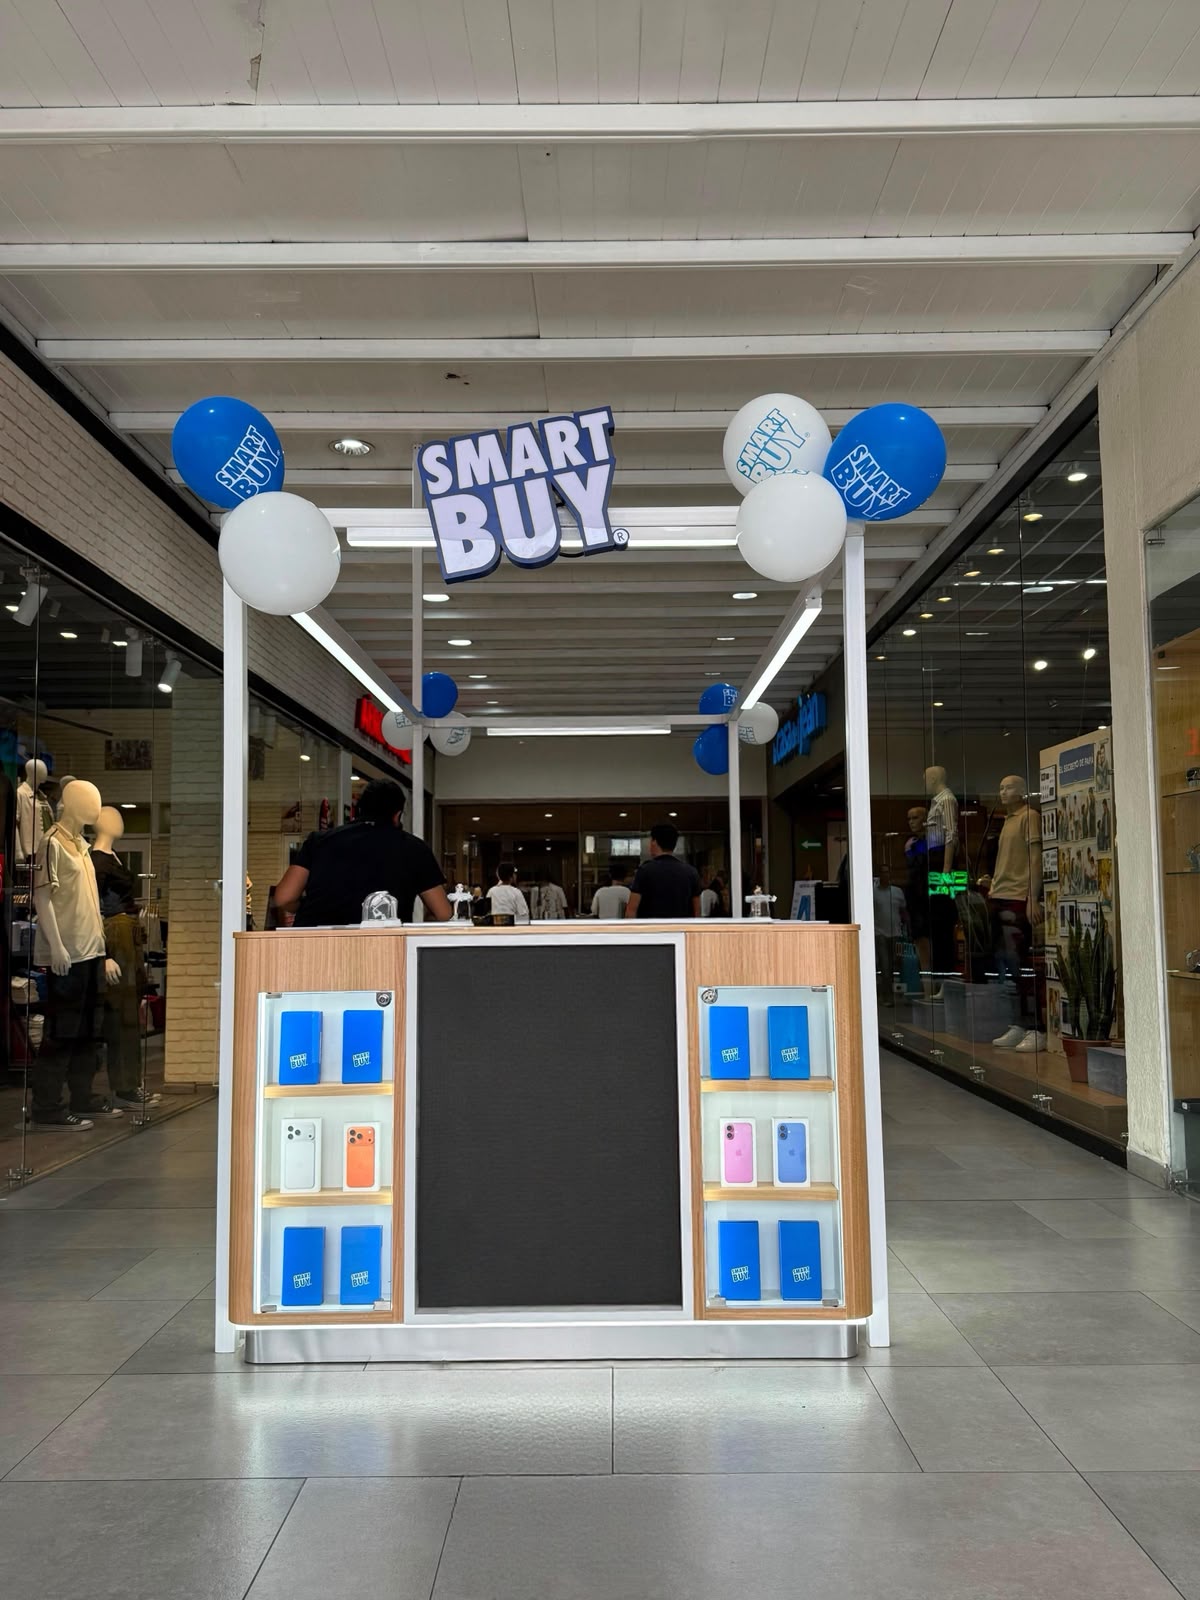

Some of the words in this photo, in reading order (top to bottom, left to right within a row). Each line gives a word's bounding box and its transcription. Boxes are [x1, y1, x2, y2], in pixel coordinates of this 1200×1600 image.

[738, 408, 786, 479] SMART
[215, 425, 266, 488] SMART
[421, 409, 611, 495] SMART
[229, 439, 279, 500] BUY
[848, 444, 911, 507] SMART
[831, 456, 896, 517] BUY
[353, 1051, 370, 1061] SMART
[722, 1047, 739, 1055] SMART
[782, 1047, 799, 1055] SMART
[290, 1052, 307, 1061] SMART
[722, 1053, 740, 1063] BUY
[782, 1053, 799, 1062] BUY
[291, 1059, 307, 1069] BUY
[353, 1059, 370, 1067] BUY
[351, 1270, 369, 1280] SMART
[732, 1266, 749, 1274] SMART
[793, 1266, 810, 1274] SMART
[293, 1271, 311, 1281] SMART
[731, 1271, 749, 1282] BUY
[793, 1271, 810, 1282] BUY
[293, 1277, 311, 1288] BUY
[351, 1277, 369, 1287] BUY
